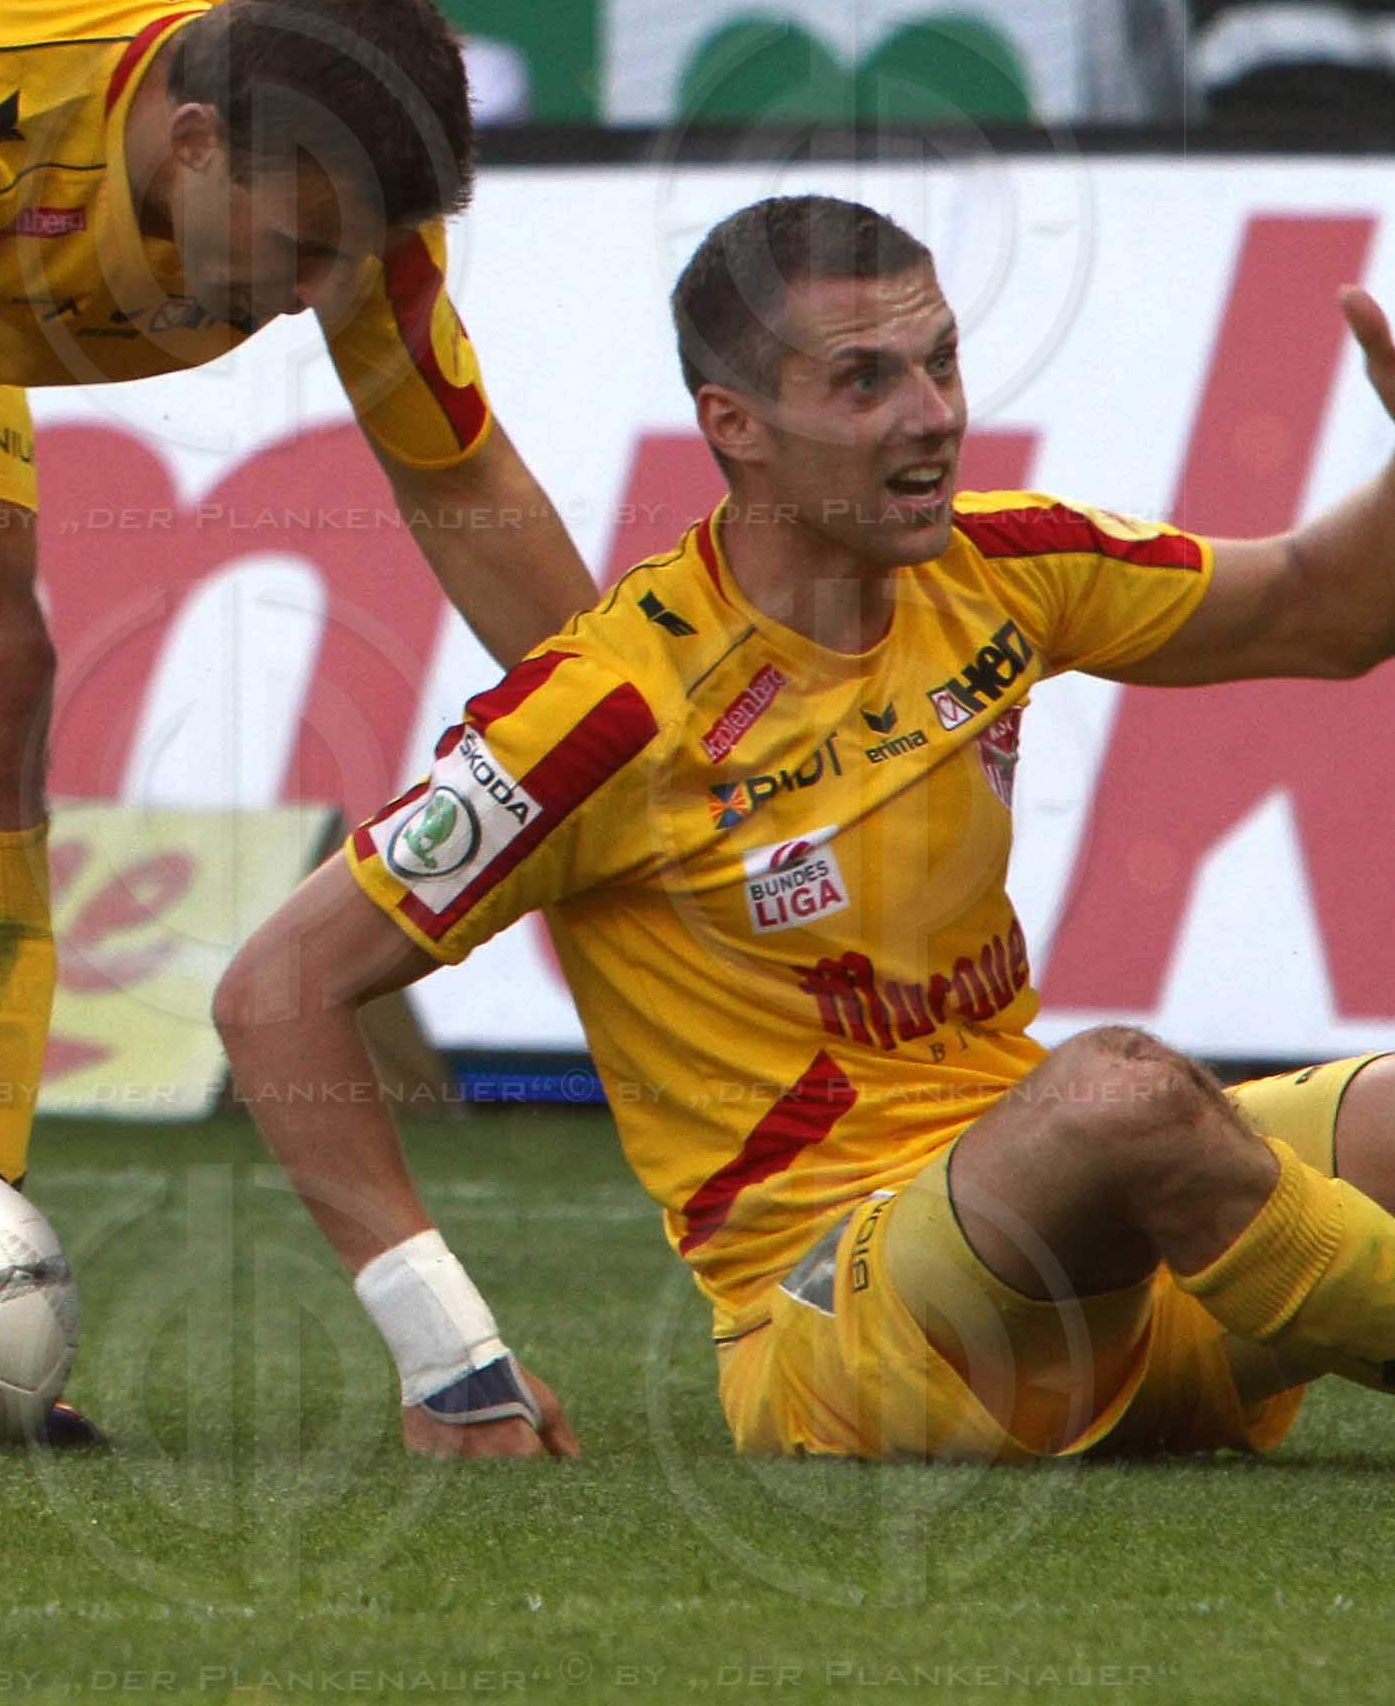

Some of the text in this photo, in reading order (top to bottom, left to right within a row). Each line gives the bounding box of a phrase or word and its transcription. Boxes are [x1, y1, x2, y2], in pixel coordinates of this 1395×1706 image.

[864, 728, 929, 765] erima
[750, 859, 830, 902] BUNDES
[755, 878, 844, 929] LIGA
